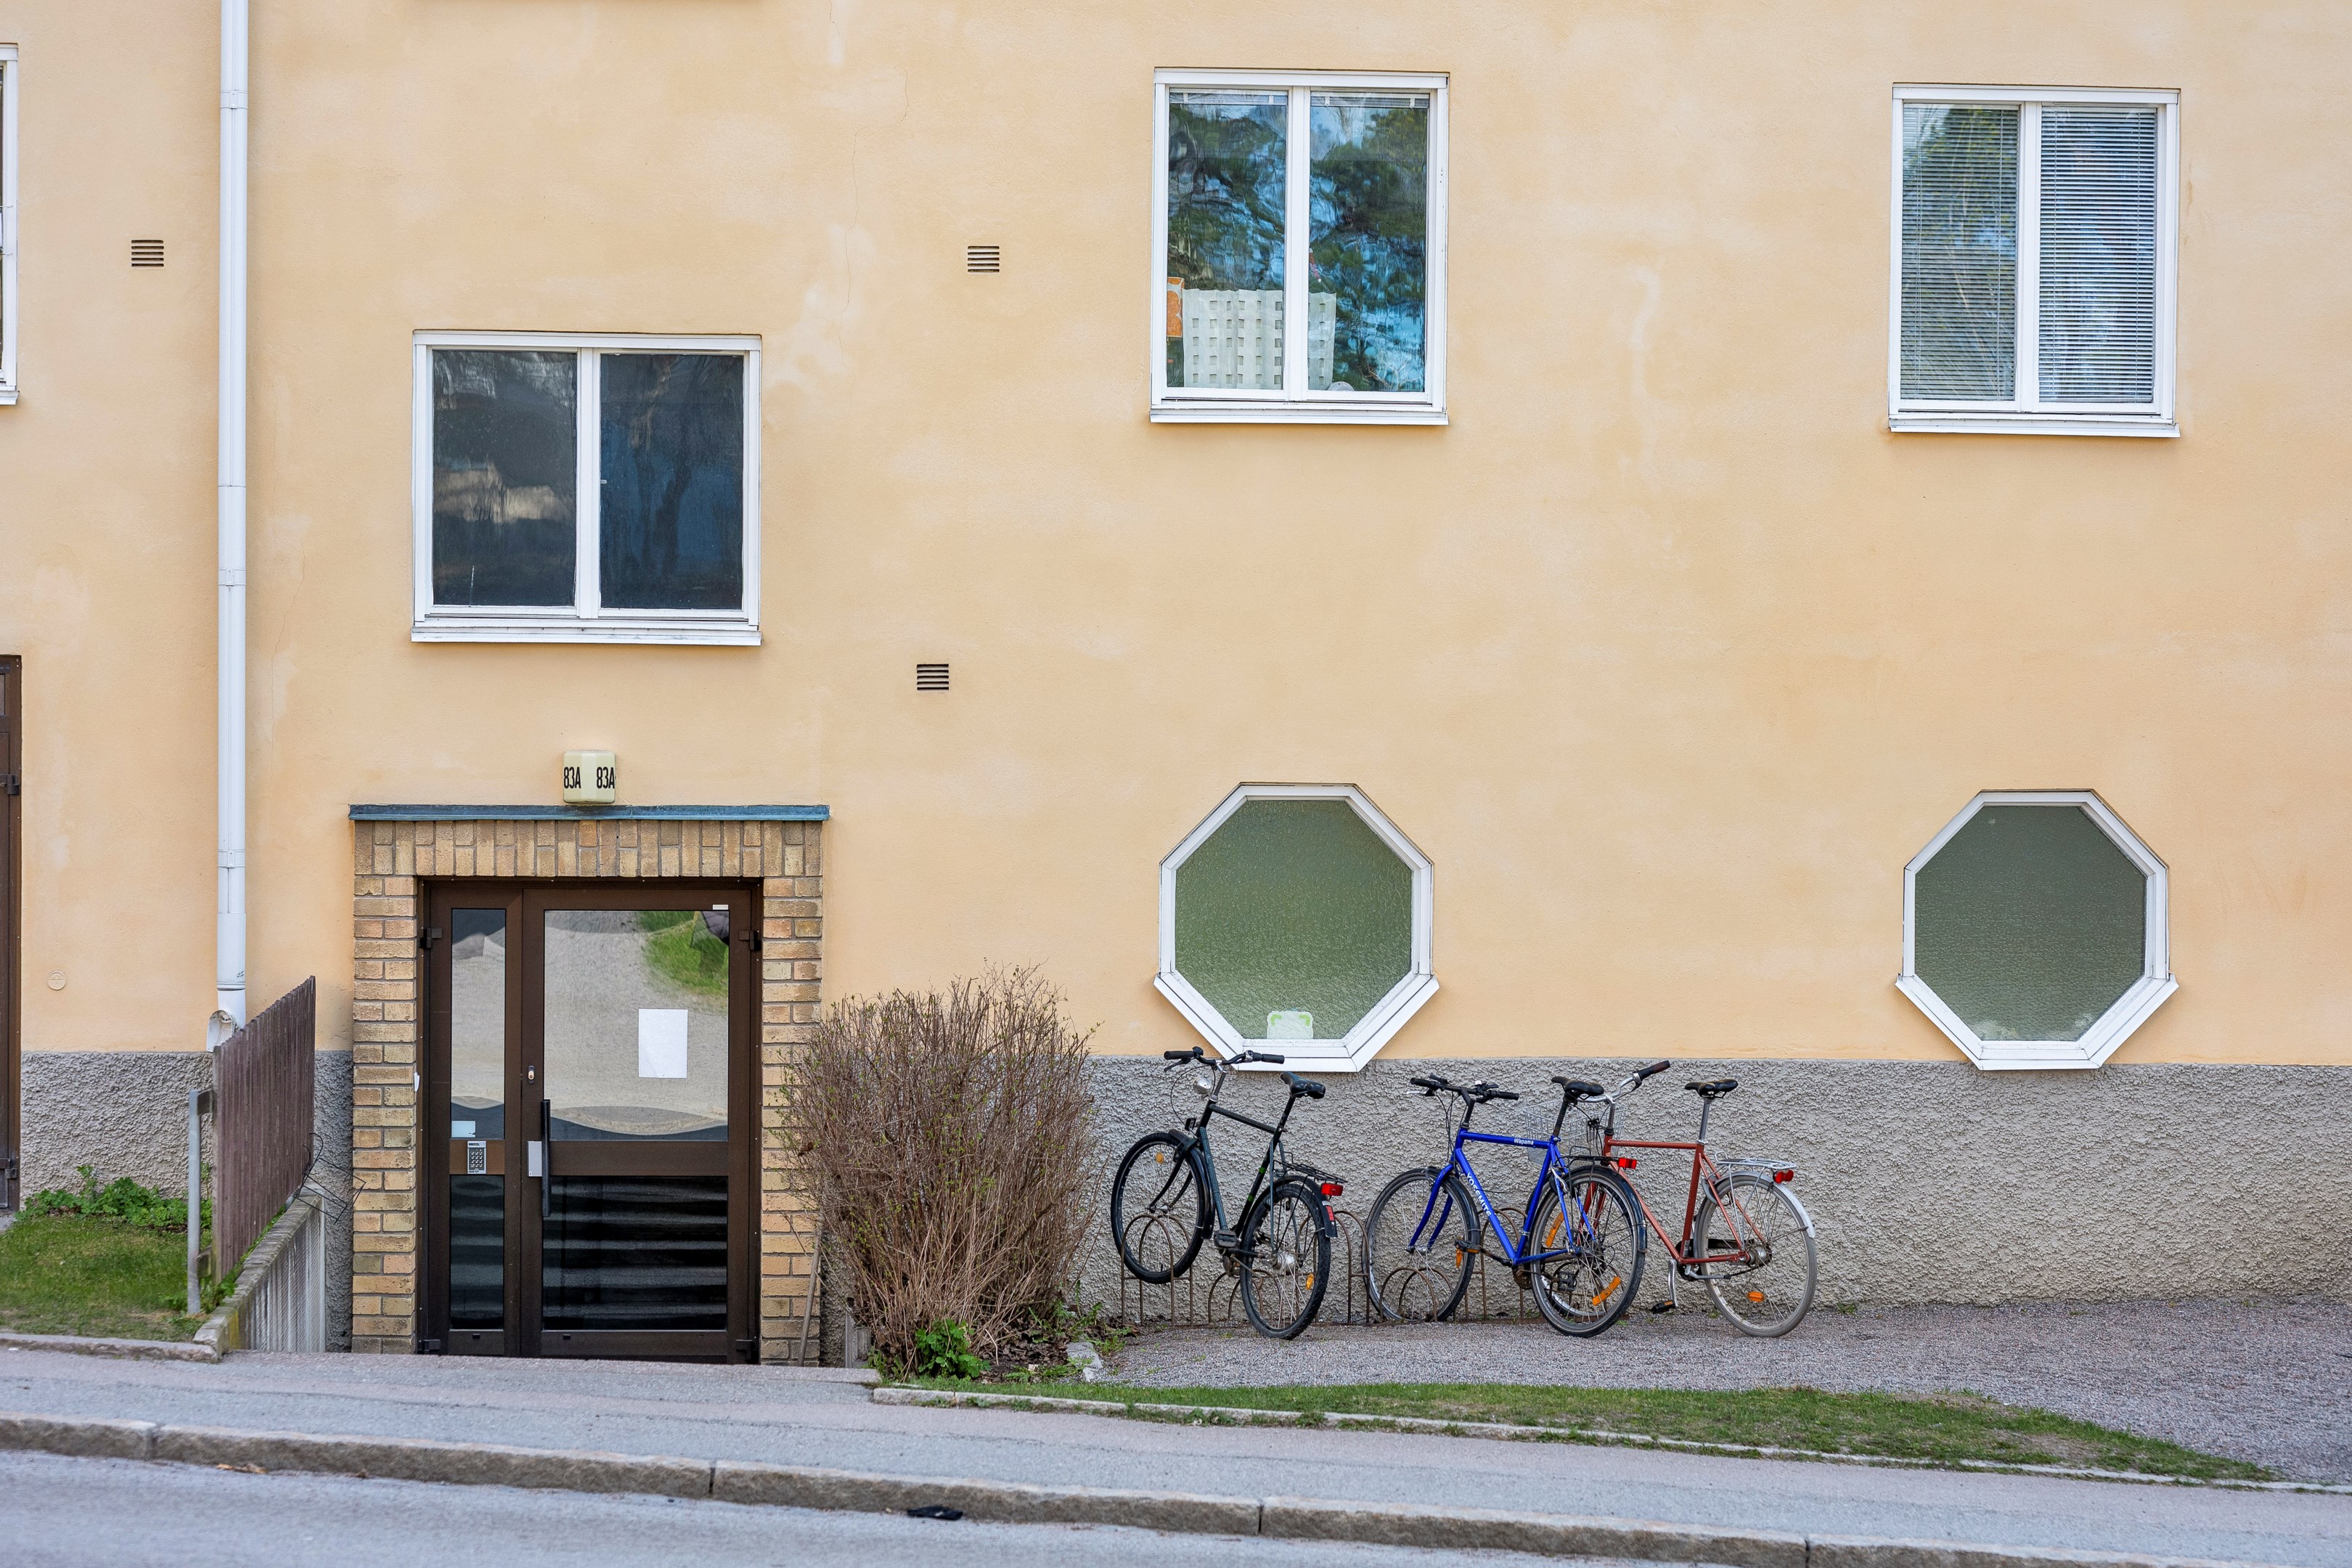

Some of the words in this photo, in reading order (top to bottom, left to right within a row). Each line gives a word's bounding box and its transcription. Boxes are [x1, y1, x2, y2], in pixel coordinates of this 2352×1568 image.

[563, 767, 581, 788] 83A
[597, 767, 615, 788] 83A
[1466, 1172, 1492, 1217] YOSEMITE
